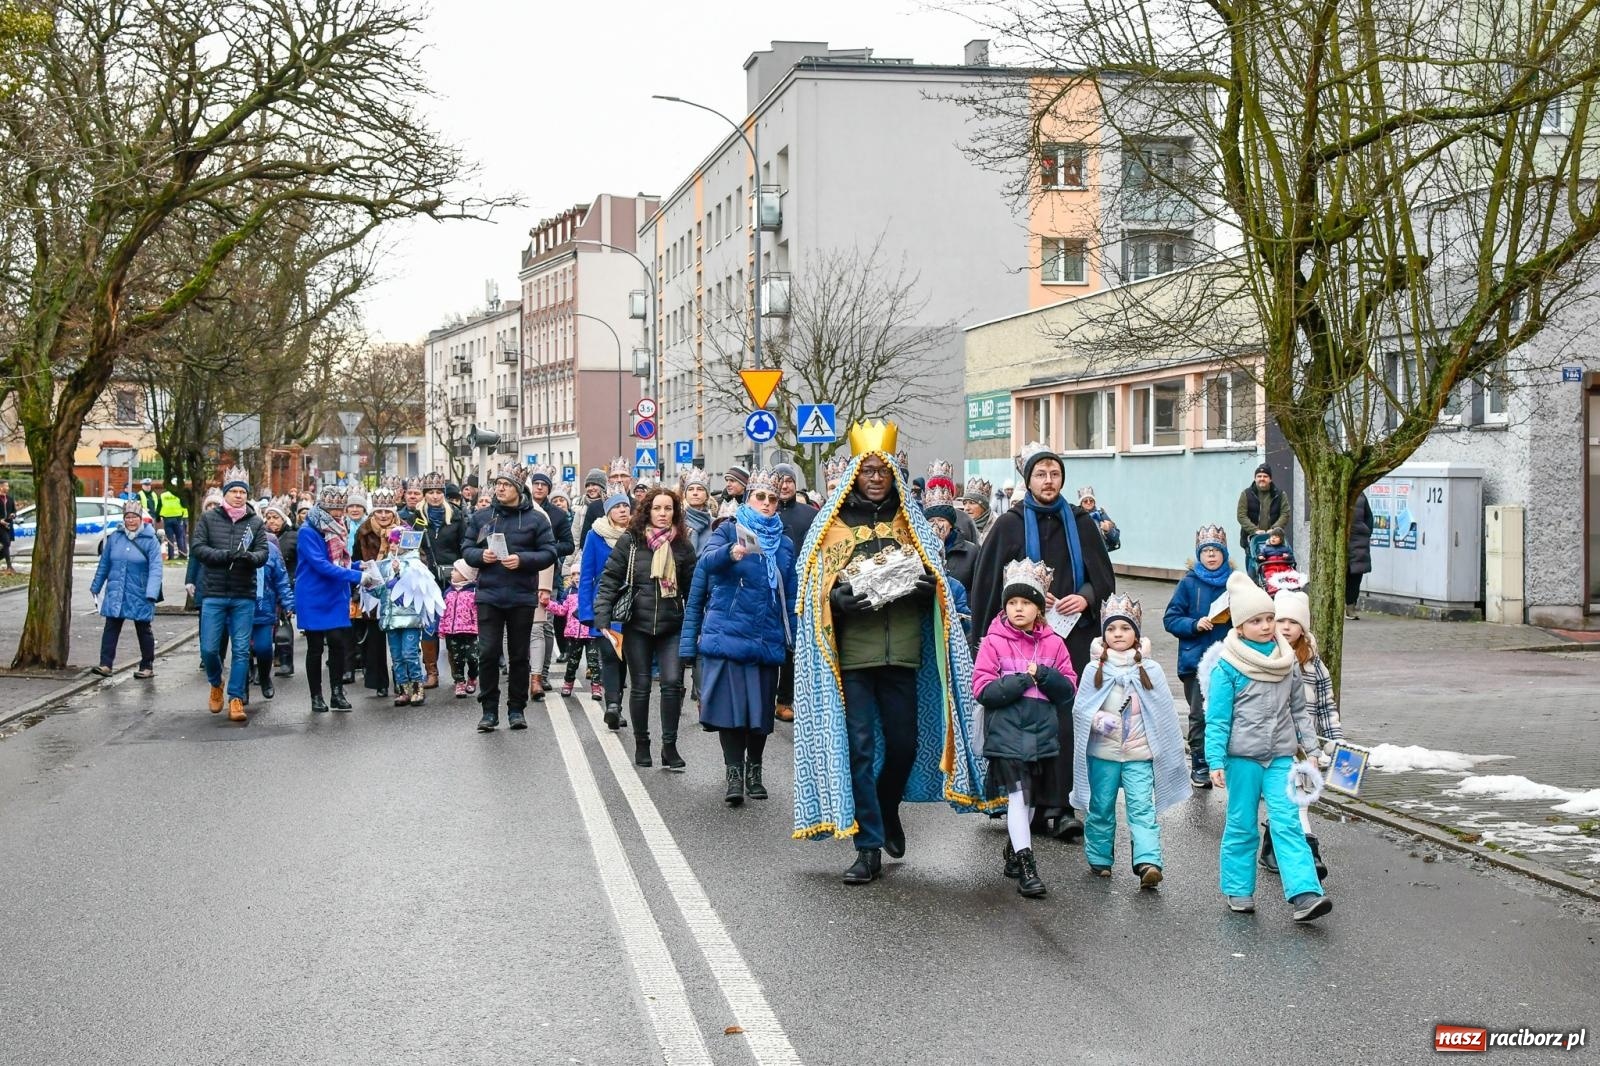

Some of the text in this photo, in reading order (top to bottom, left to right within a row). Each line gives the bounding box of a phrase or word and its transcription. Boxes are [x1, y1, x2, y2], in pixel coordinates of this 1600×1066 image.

[981, 399, 994, 417] MED
[679, 443, 690, 457] P
[565, 467, 574, 478] P
[1426, 487, 1443, 504] J12
